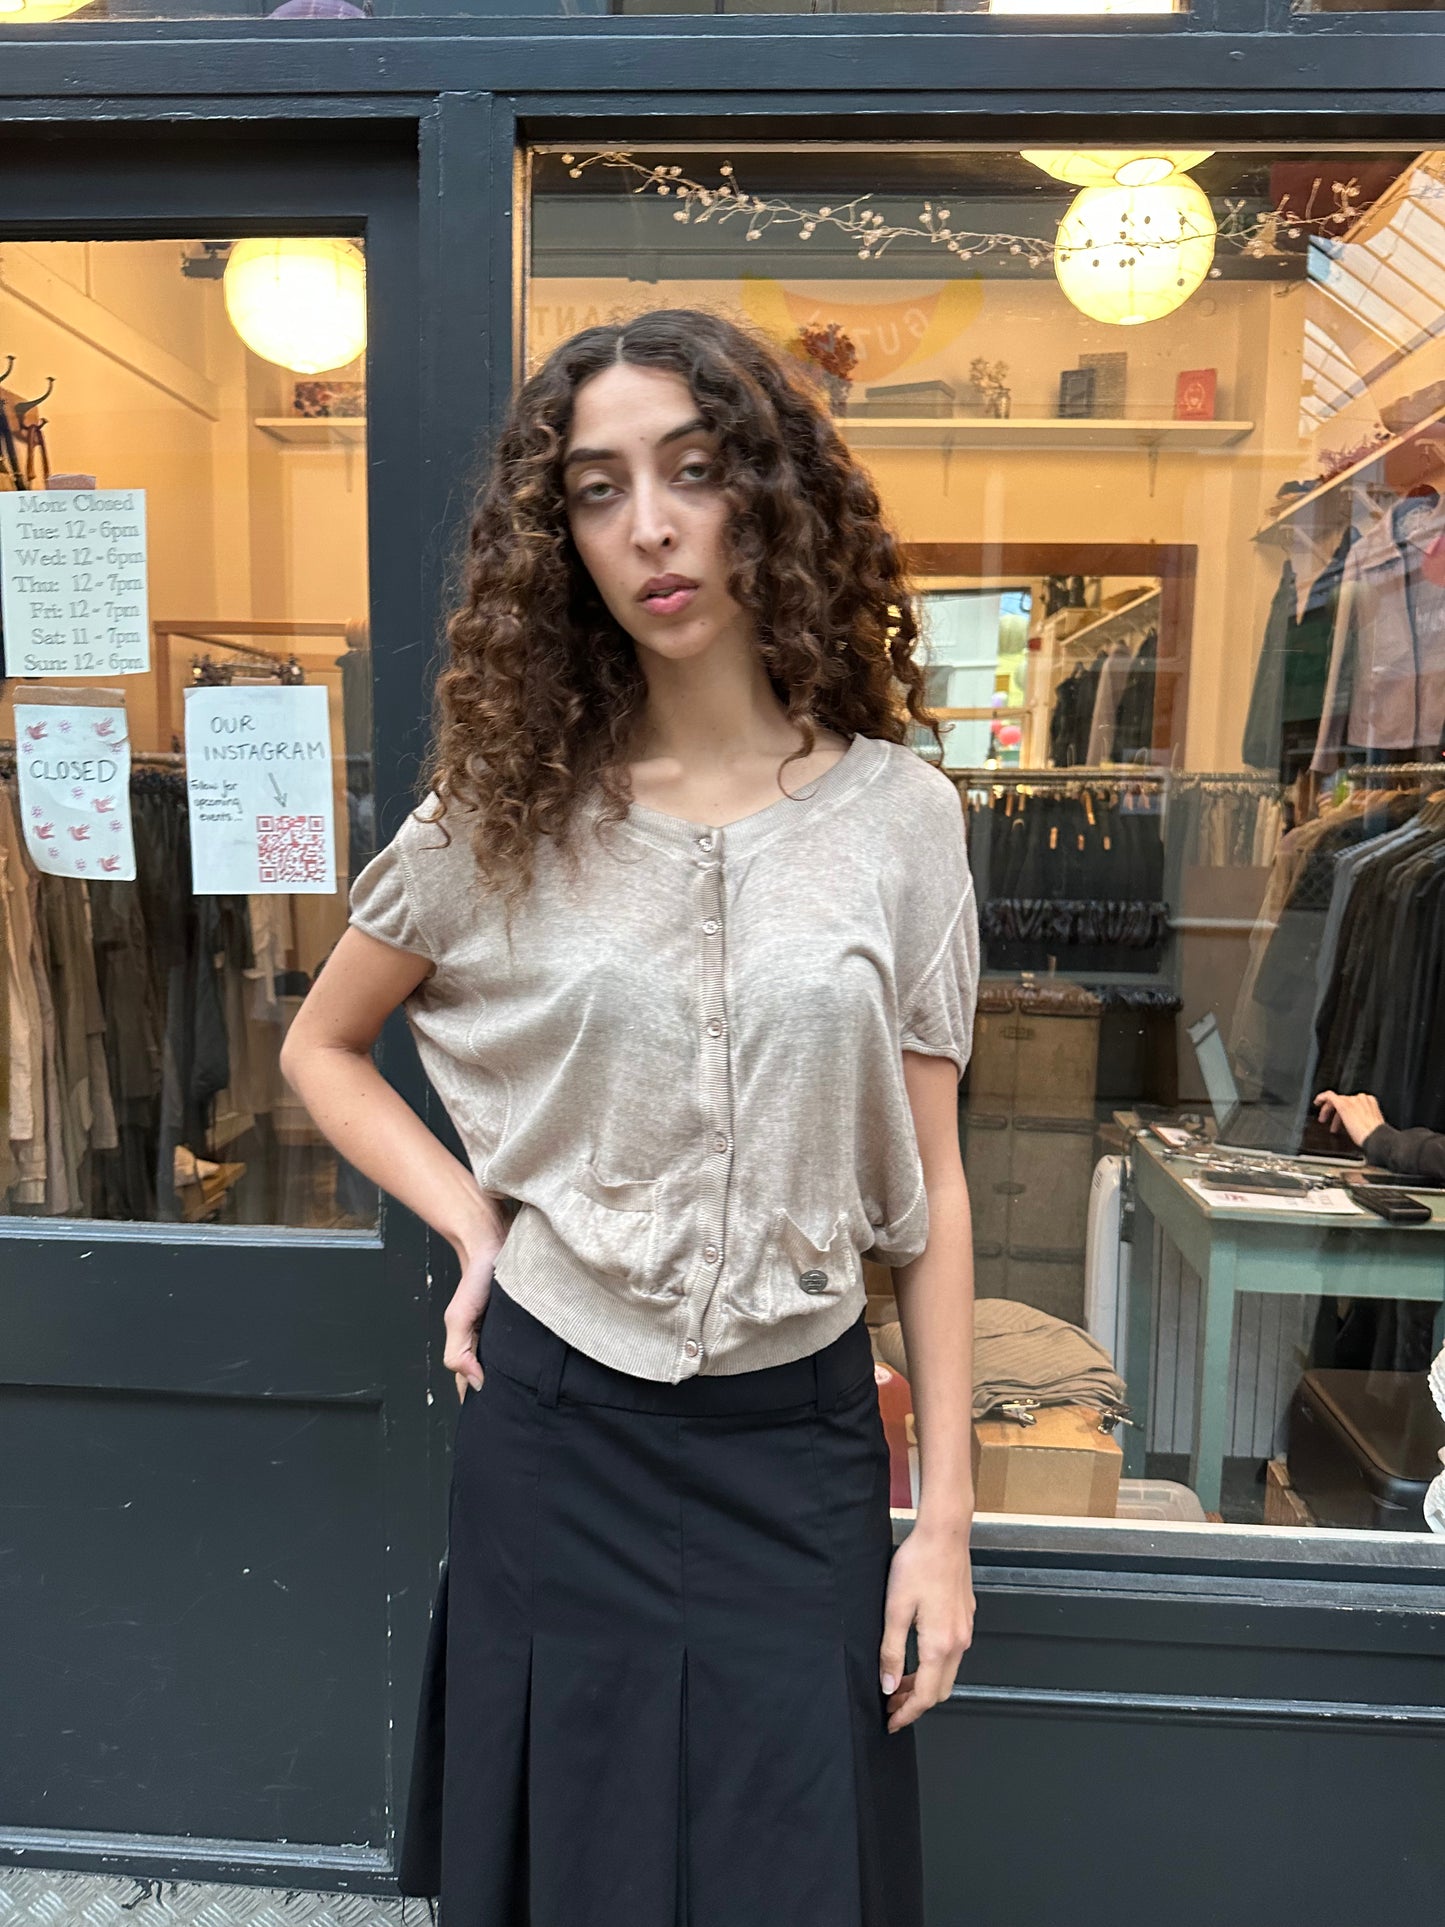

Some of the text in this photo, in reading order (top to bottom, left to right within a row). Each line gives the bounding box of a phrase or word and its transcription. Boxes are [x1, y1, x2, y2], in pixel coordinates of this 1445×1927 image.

[18, 493, 135, 513] Mon: Closed
[16, 522, 60, 540] Tue:
[14, 548, 66, 566] Wed:
[11, 575, 60, 593] Thu:
[29, 602, 63, 619] Fri:
[31, 628, 67, 645] Sat:
[23, 653, 67, 671] Sun:
[210, 714, 256, 734] OUR
[203, 741, 326, 761] INSTAGRAM
[29, 759, 118, 783] CLOSED
